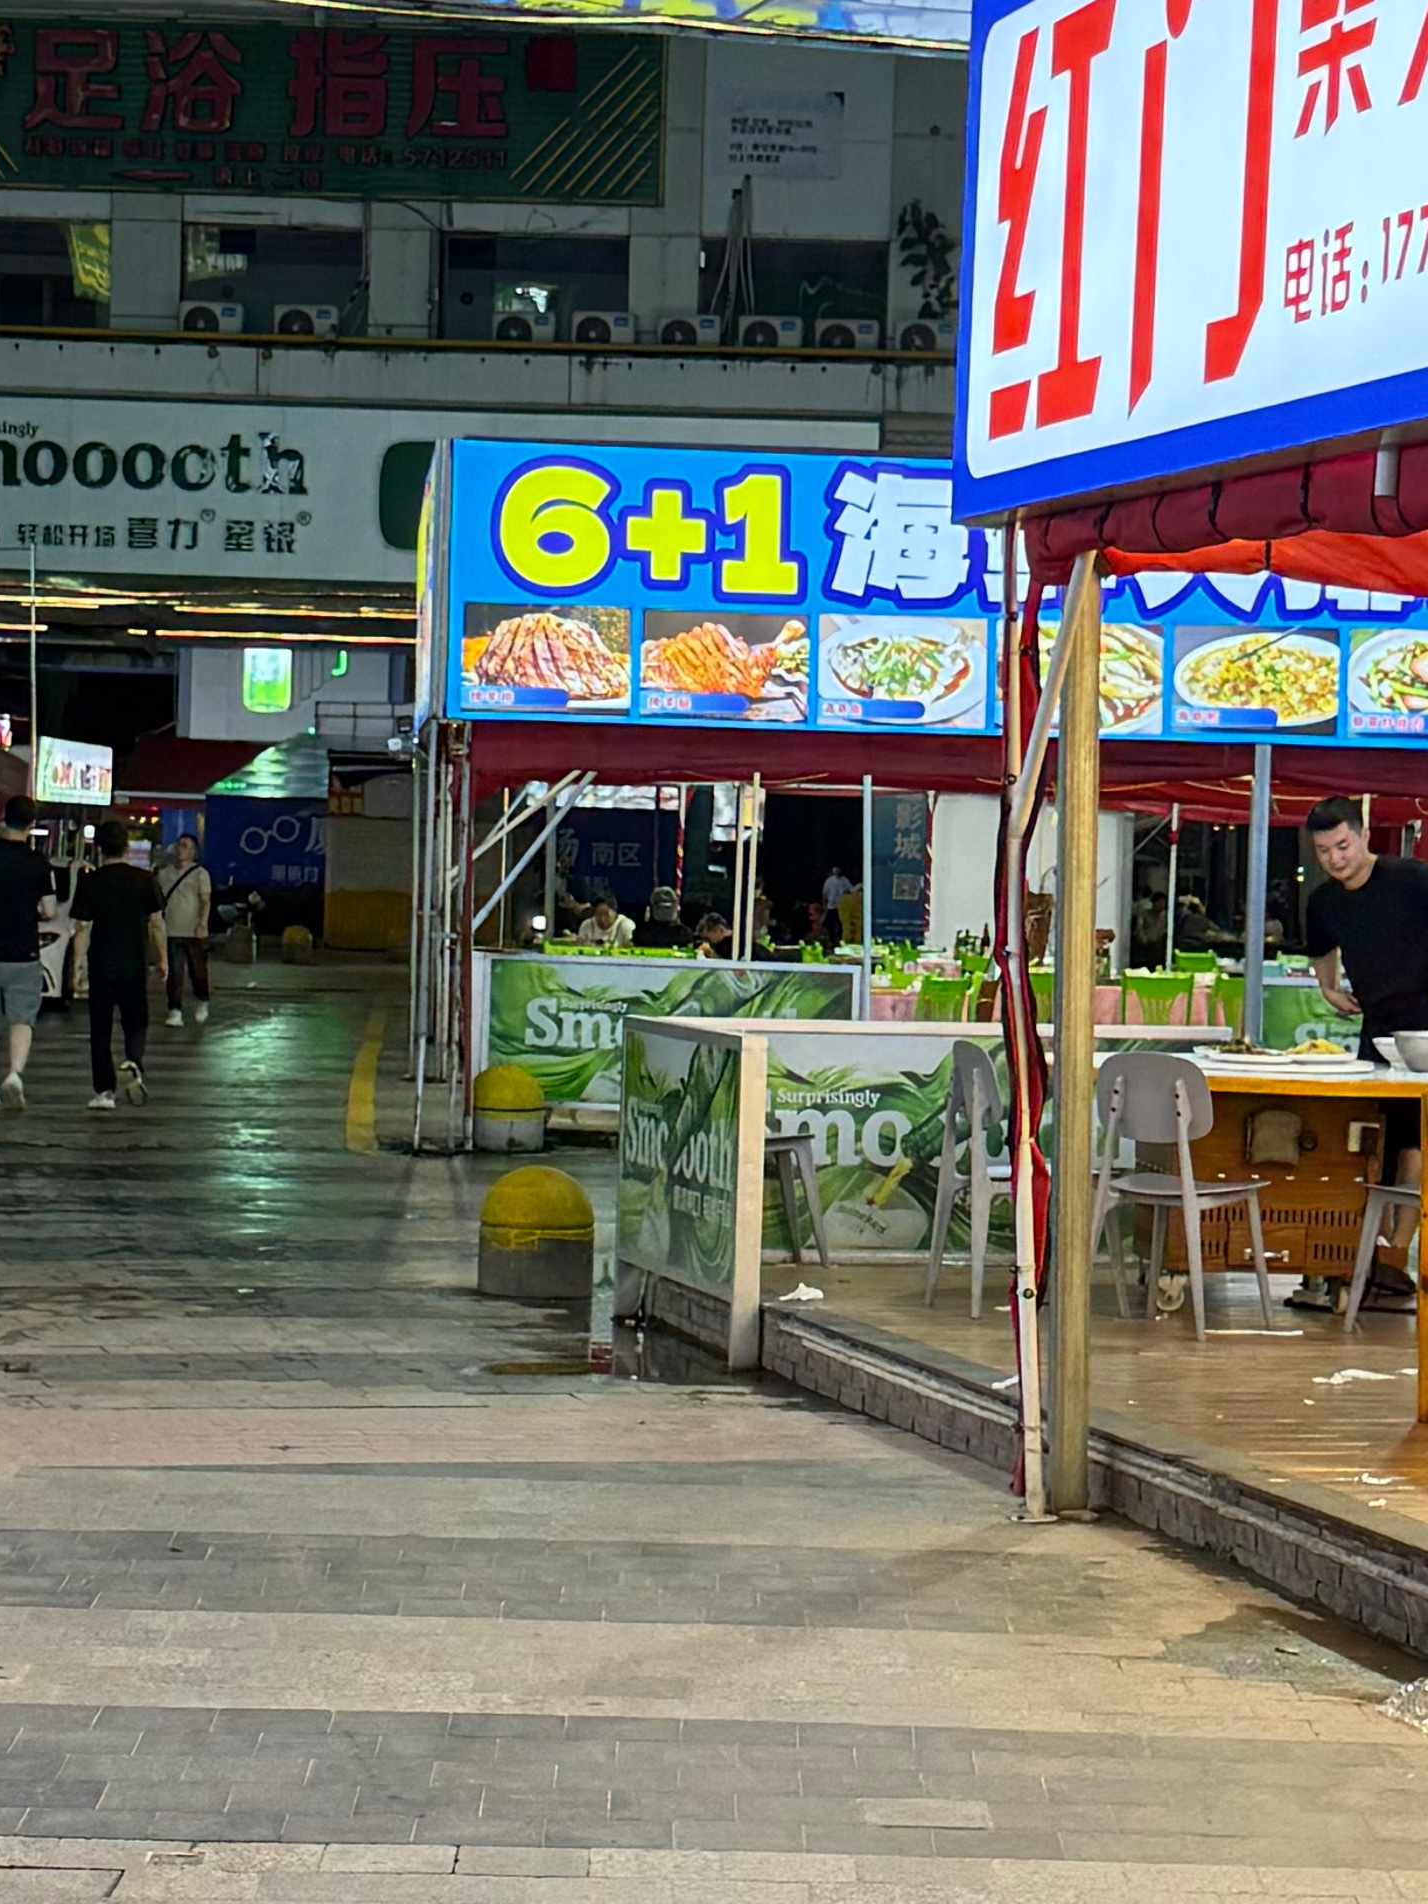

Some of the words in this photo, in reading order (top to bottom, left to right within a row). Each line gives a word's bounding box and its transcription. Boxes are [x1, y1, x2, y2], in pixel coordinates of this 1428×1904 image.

[25, 28, 242, 132] 足浴
[287, 30, 510, 142] 指压
[17, 523, 116, 549] 轻松开场
[498, 464, 801, 595] 6+1
[590, 841, 642, 868] 南区
[776, 1087, 881, 1109] Surprisingly
